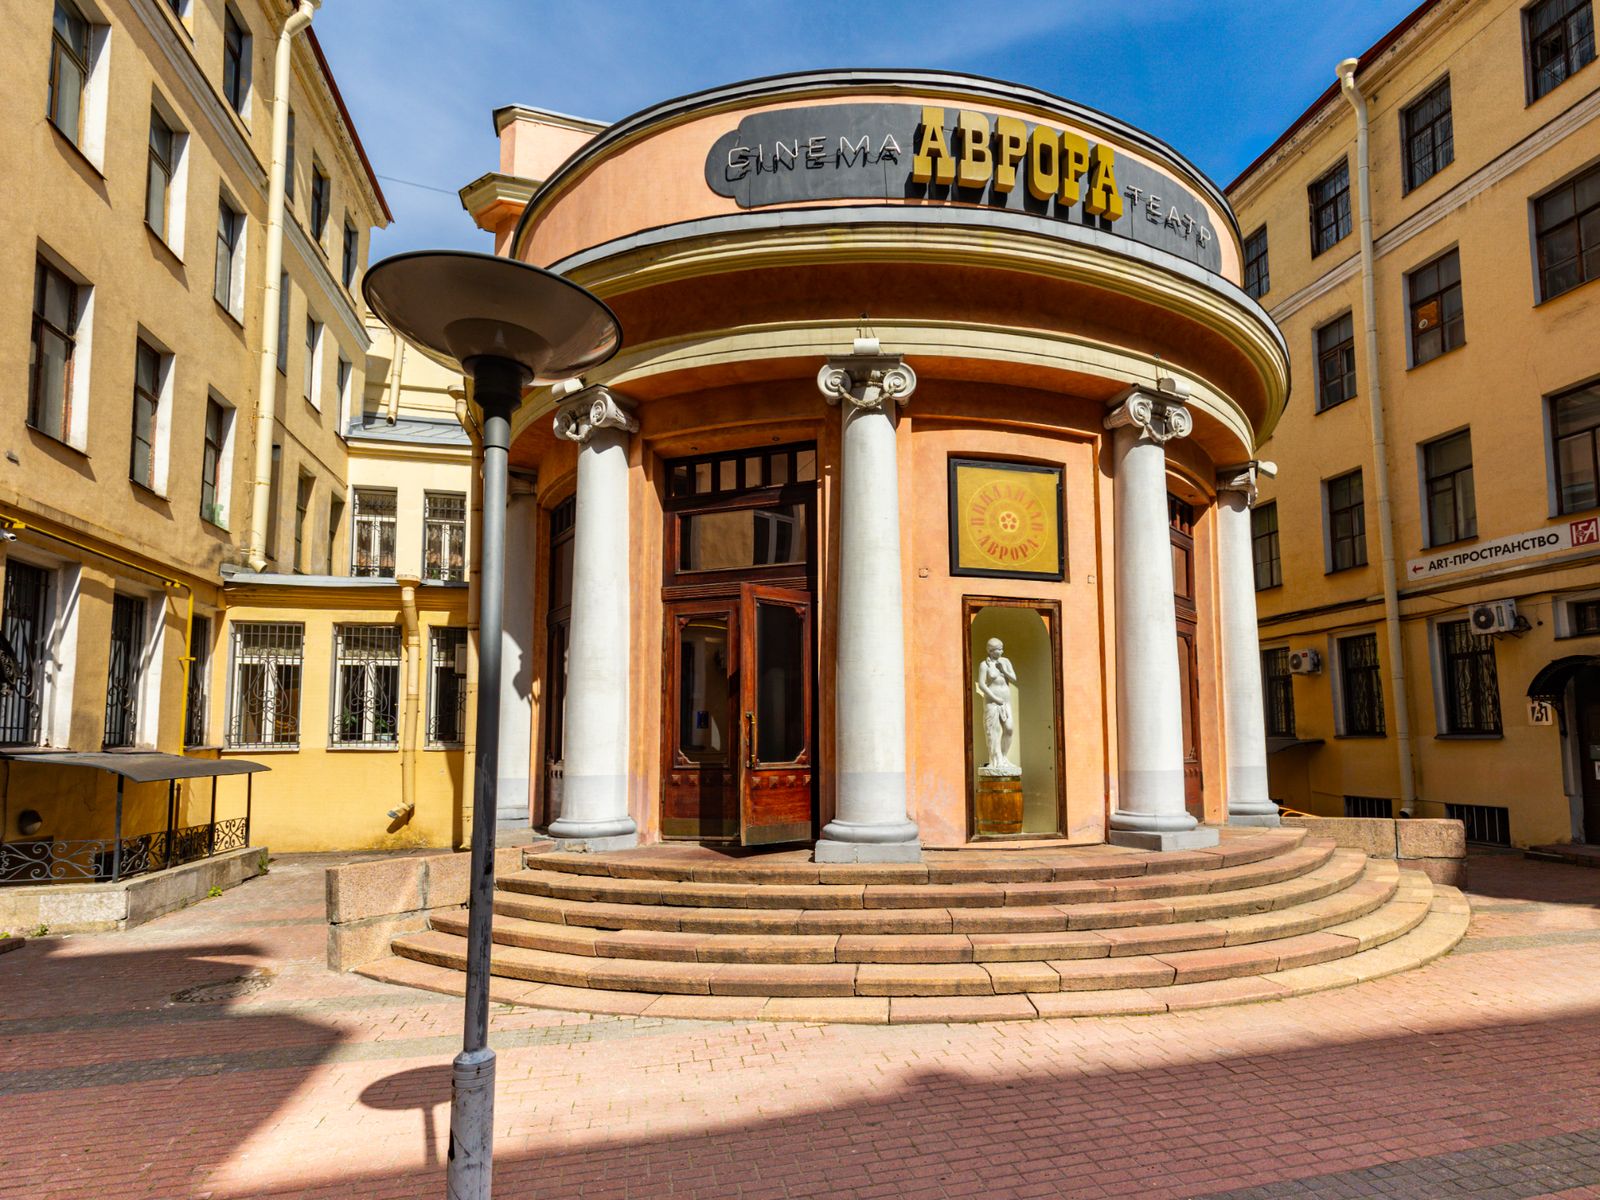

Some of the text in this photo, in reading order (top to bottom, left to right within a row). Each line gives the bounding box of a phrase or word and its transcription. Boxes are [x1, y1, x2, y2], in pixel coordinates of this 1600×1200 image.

[728, 105, 1212, 241] CINEMA АВРОРА ТЕАТР
[978, 535, 1040, 561] АВРОРА
[1428, 533, 1560, 572] ART-ПРОСТРАНСТВО
